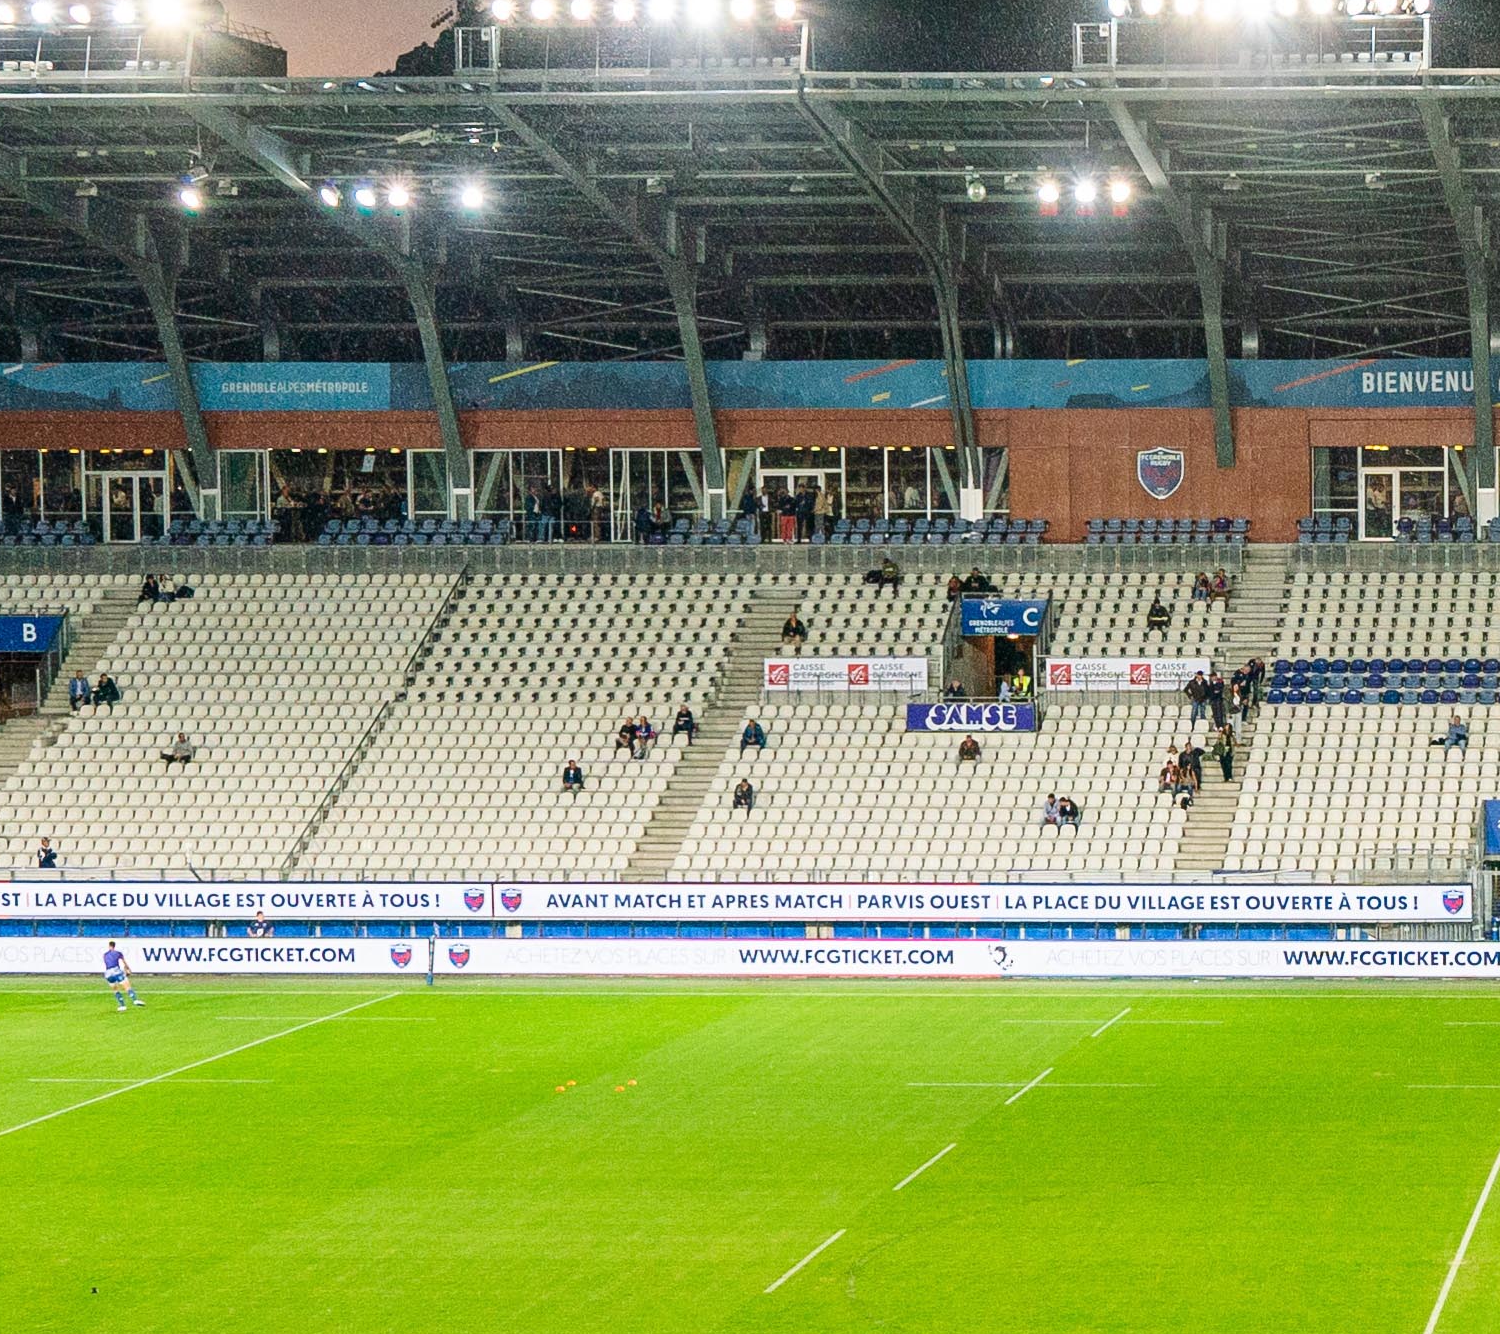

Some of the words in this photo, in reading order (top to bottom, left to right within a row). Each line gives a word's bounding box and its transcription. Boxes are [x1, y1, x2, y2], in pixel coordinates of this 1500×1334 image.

[1363, 371, 1474, 393] BIENVENU
[1023, 607, 1038, 627] C
[22, 622, 37, 642] B
[925, 703, 1016, 731] SAMSE
[35, 893, 57, 907] LA
[62, 893, 118, 907] PLACE
[123, 893, 149, 907] DU
[154, 893, 231, 908] VILLAGE
[236, 893, 266, 908] EST
[270, 893, 357, 908] OUVERTE
[362, 890, 375, 908] À
[379, 893, 430, 908] TOUS
[546, 894, 609, 908] AVANT
[614, 894, 681, 909] MATCH
[687, 894, 706, 909] ET
[711, 894, 769, 909] APRES
[775, 894, 843, 909] MATCH
[857, 894, 925, 909] PARVIS
[929, 894, 991, 910] OUEST
[1005, 895, 1027, 910] LA
[1033, 895, 1089, 910] PLACE
[1094, 895, 1121, 910] DU
[1126, 895, 1205, 910] VILLAGE
[1210, 895, 1241, 910] EST
[1245, 895, 1333, 911] OUVERTE
[1338, 892, 1351, 911] À
[1356, 895, 1408, 911] TOUS
[142, 947, 355, 963] WWW.FCGTICKET.COM
[739, 949, 954, 965] WWW.FCGTICKET.COM
[1283, 950, 1500, 966] WWW.FCGTICKET.COM
